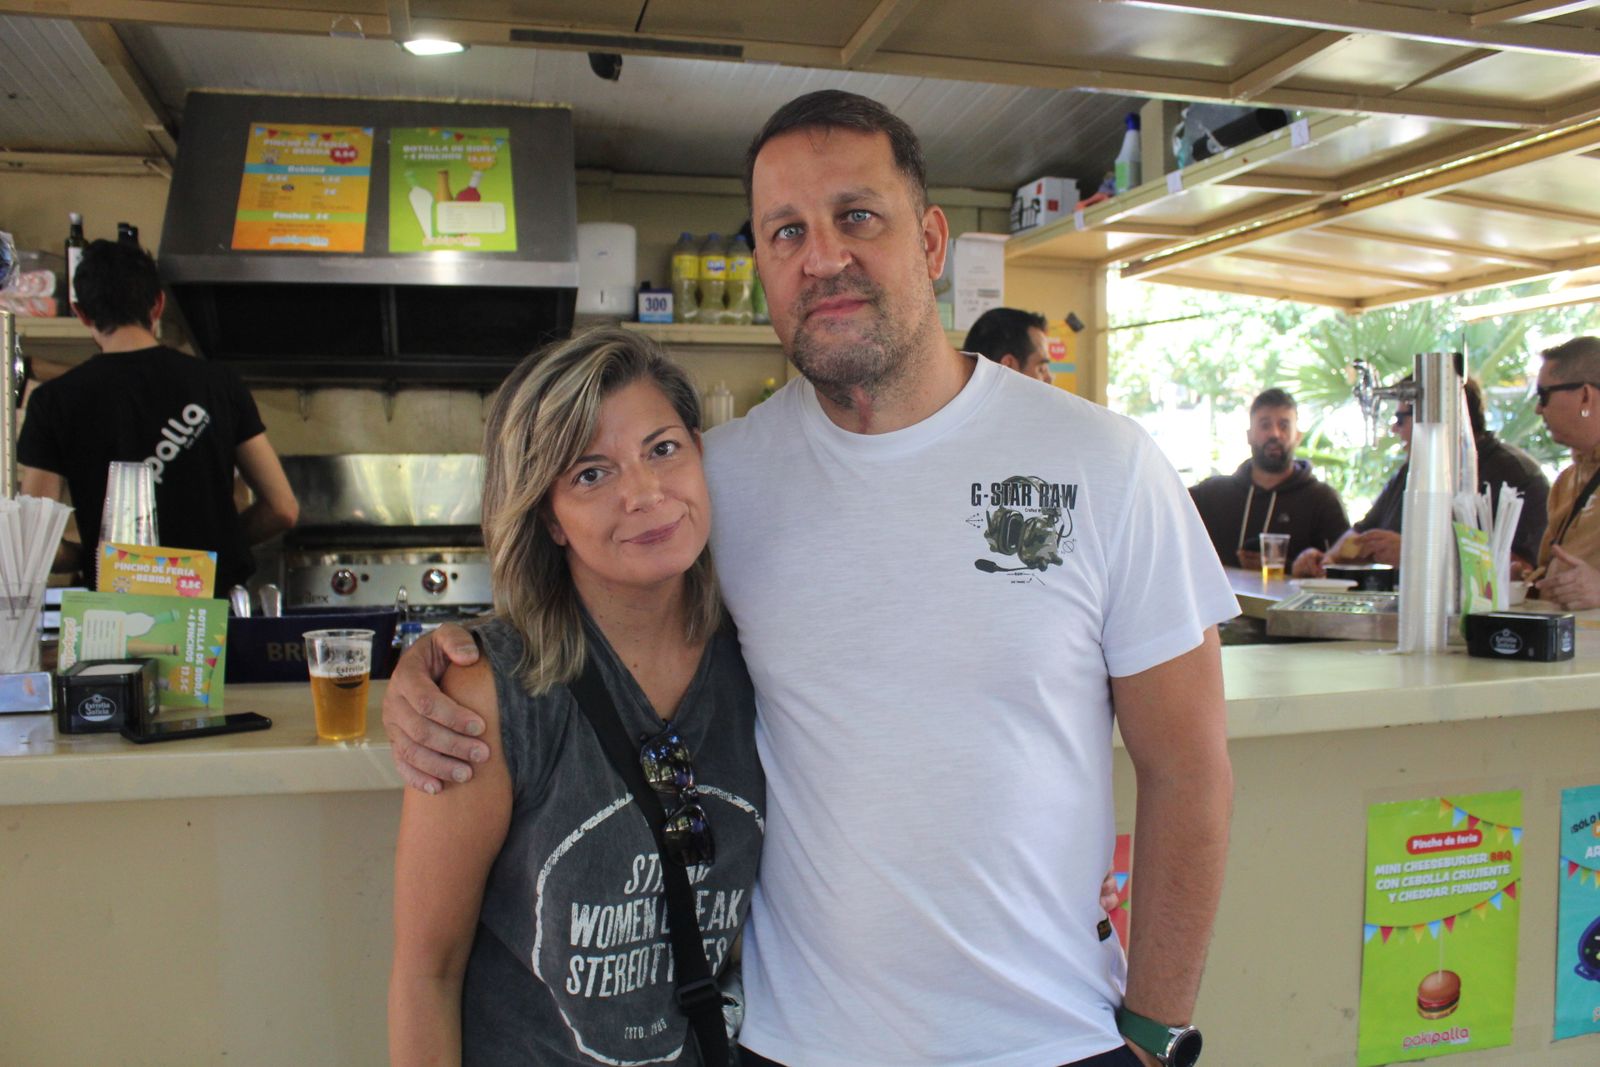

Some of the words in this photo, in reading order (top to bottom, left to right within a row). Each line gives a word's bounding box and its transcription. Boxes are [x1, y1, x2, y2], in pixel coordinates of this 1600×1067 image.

[645, 297, 667, 311] 300
[971, 482, 1032, 507] G-STAR
[1039, 483, 1078, 510] RAW
[114, 562, 151, 573] PINCHO
[152, 565, 165, 574] DE
[166, 567, 195, 577] FERIA
[196, 608, 207, 652] BOTELLA
[195, 653, 205, 665] DE
[1412, 838, 1442, 850] Pincho
[1444, 836, 1455, 846] de
[1457, 834, 1478, 844] feria
[1375, 864, 1401, 876] MINI
[1404, 853, 1489, 873] CHEESEBURGER
[1490, 850, 1512, 862] BBQ
[1376, 878, 1400, 890] CON
[1402, 872, 1451, 887] CEBOLLA
[1452, 864, 1511, 880] CRUJIENTE
[1388, 893, 1397, 902] Y
[1399, 886, 1449, 902] CHEDDAR
[1451, 880, 1498, 894] FUNDIDO
[570, 896, 658, 950] WOMEN
